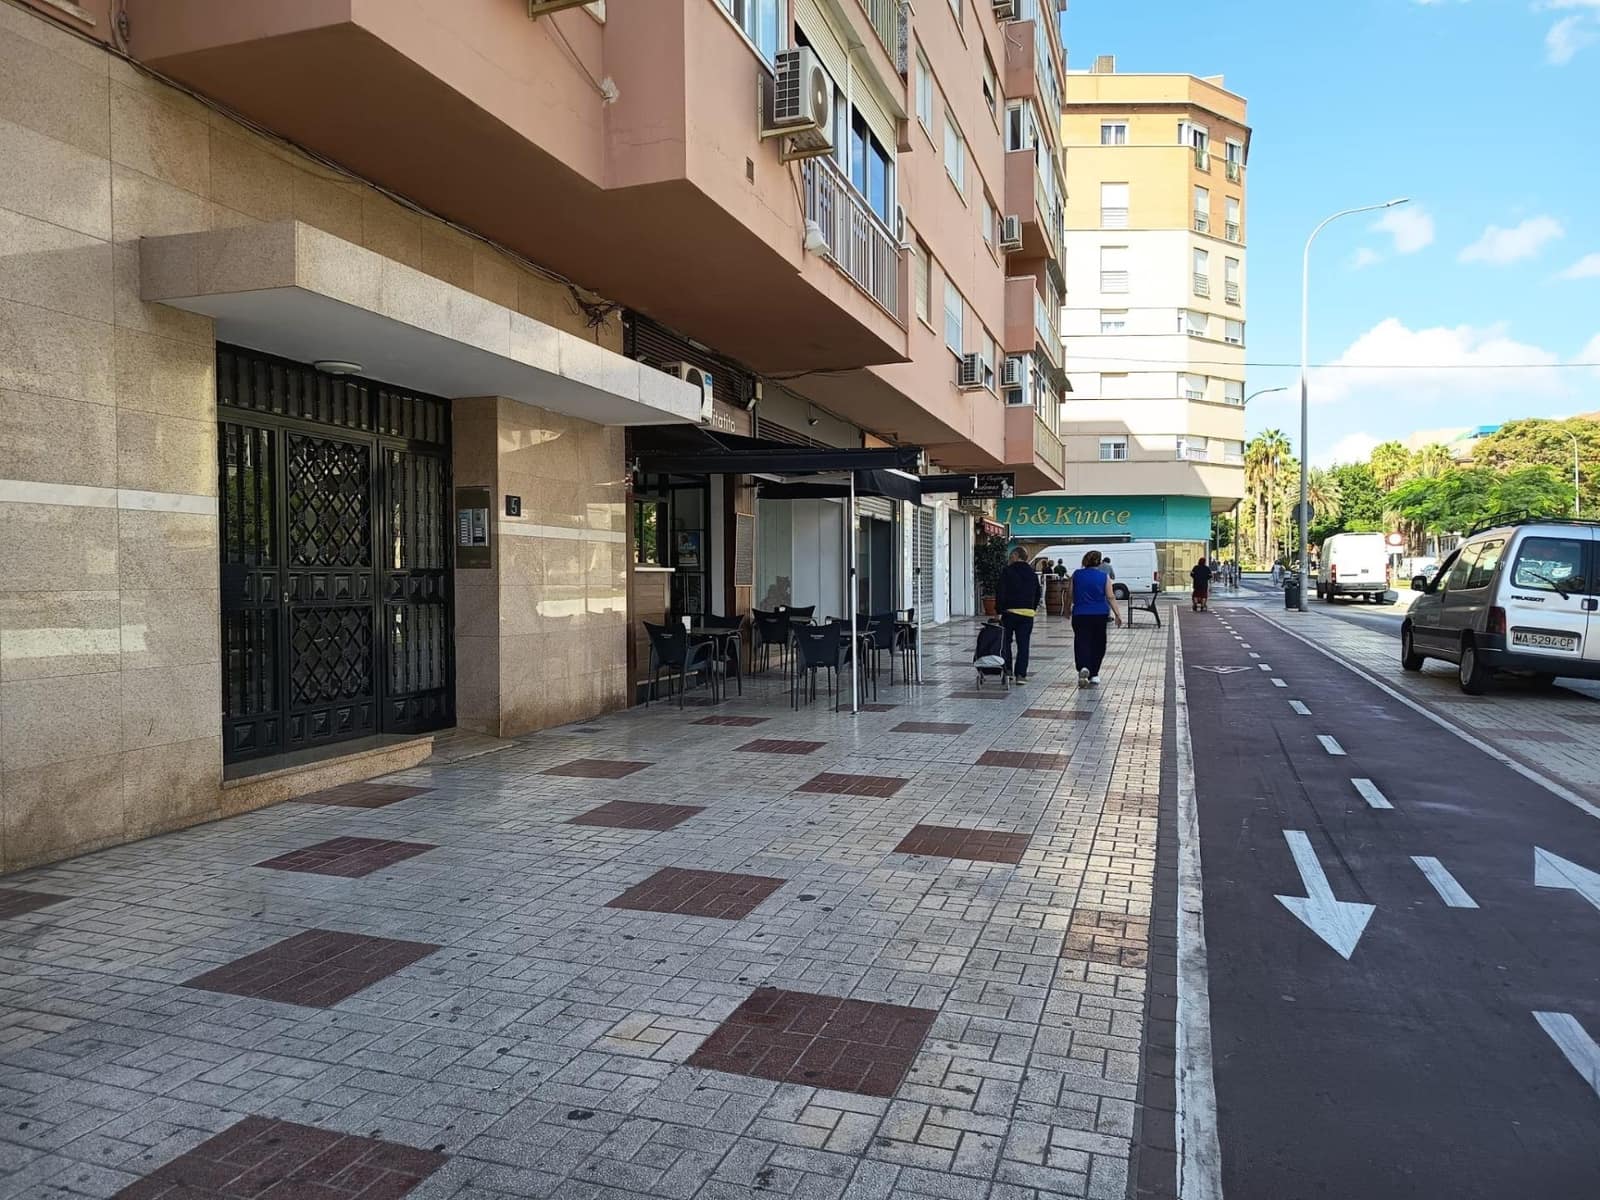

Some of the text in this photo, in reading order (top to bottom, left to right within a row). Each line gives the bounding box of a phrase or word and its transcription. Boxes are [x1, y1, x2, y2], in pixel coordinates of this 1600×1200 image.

[709, 408, 736, 433] itatito
[511, 497, 518, 514] 5
[1511, 595, 1545, 603] PEUGEOT
